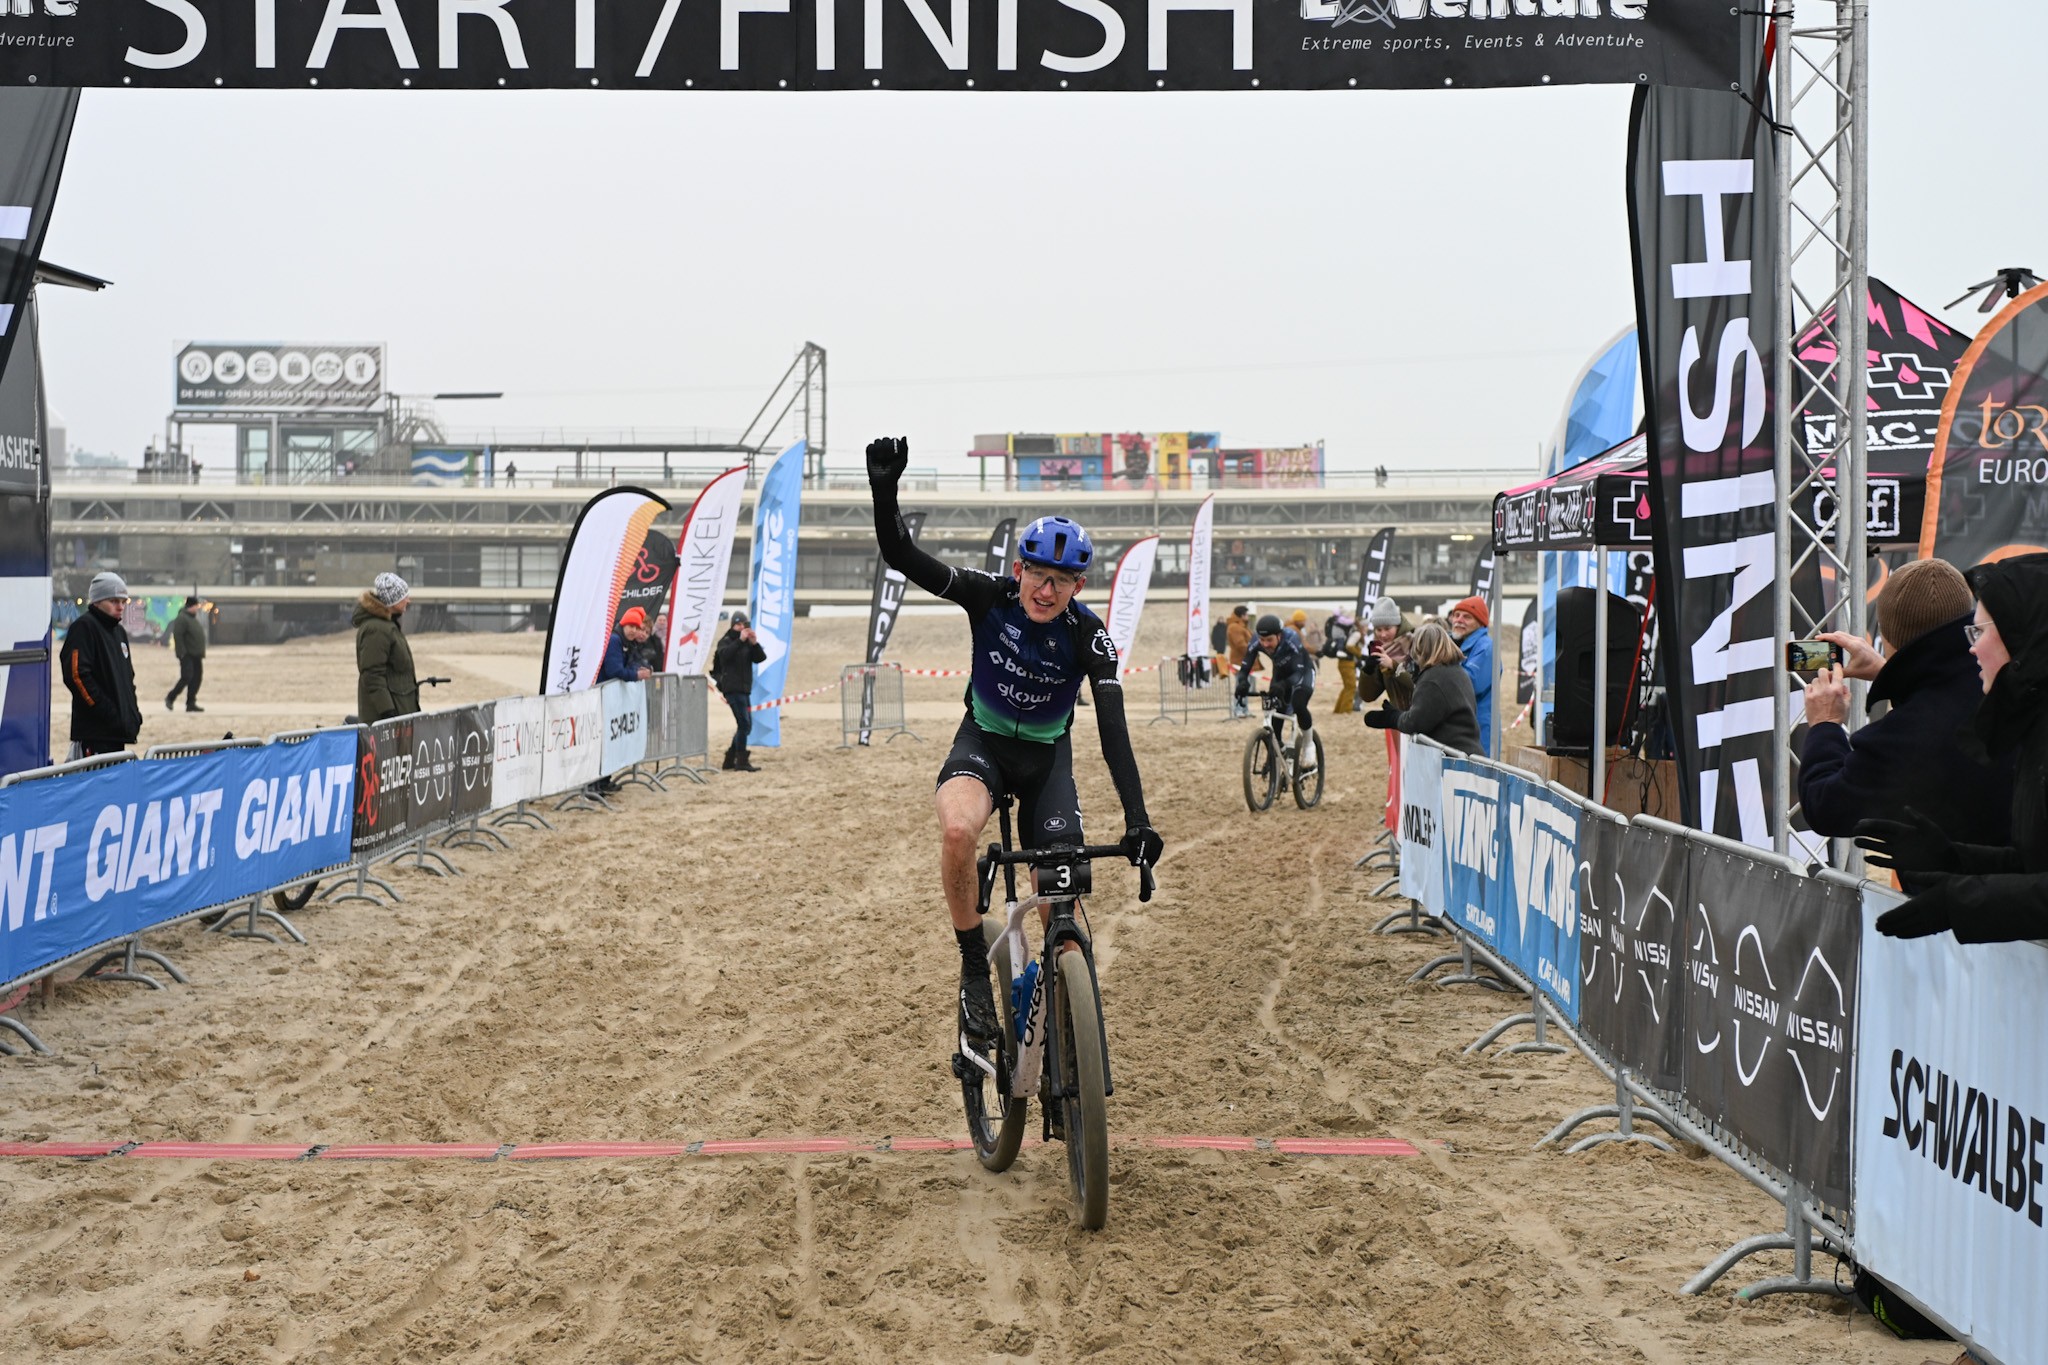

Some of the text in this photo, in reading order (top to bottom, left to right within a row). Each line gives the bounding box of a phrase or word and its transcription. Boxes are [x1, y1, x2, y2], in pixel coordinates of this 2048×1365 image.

[1302, 32, 1645, 52] Extreme sports, Events & Adventure
[997, 682, 1052, 704] glowi
[235, 764, 354, 860] GIANT
[85, 788, 224, 902] GIANT
[1056, 865, 1071, 888] 3
[1734, 984, 1780, 1027] NISSAN
[1882, 1048, 2046, 1228] SCHWALBE
